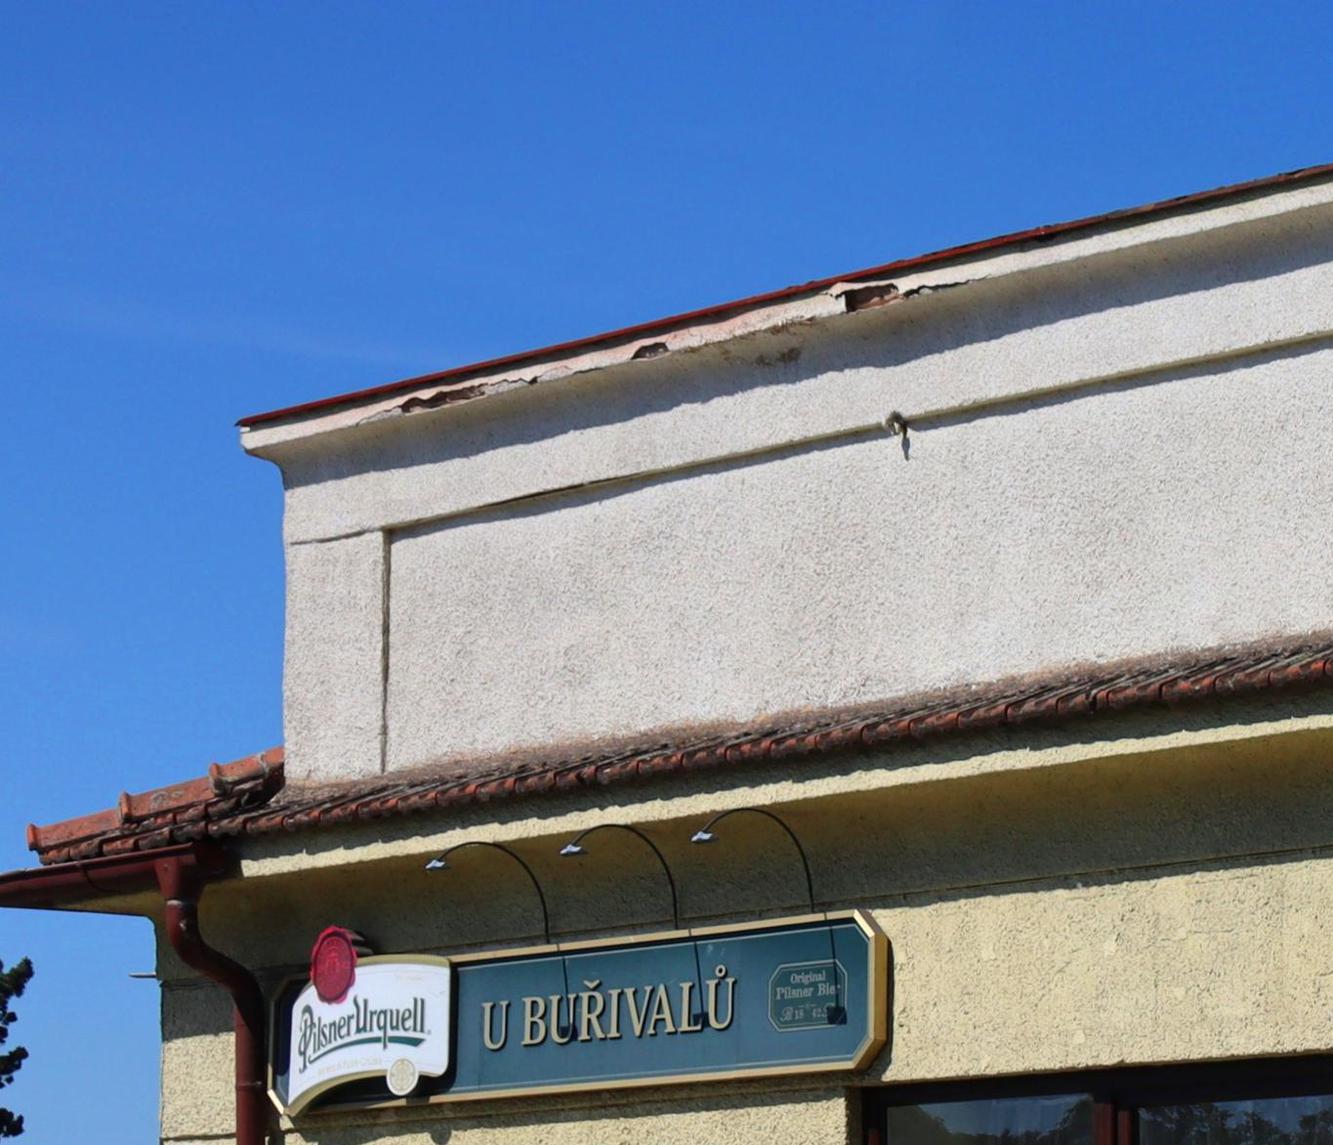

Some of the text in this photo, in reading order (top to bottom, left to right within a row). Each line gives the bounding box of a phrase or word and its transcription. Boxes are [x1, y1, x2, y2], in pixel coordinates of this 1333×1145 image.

[298, 996, 426, 1073] Pilsner Urquell
[482, 965, 736, 1051] U BUŘIVALŮ
